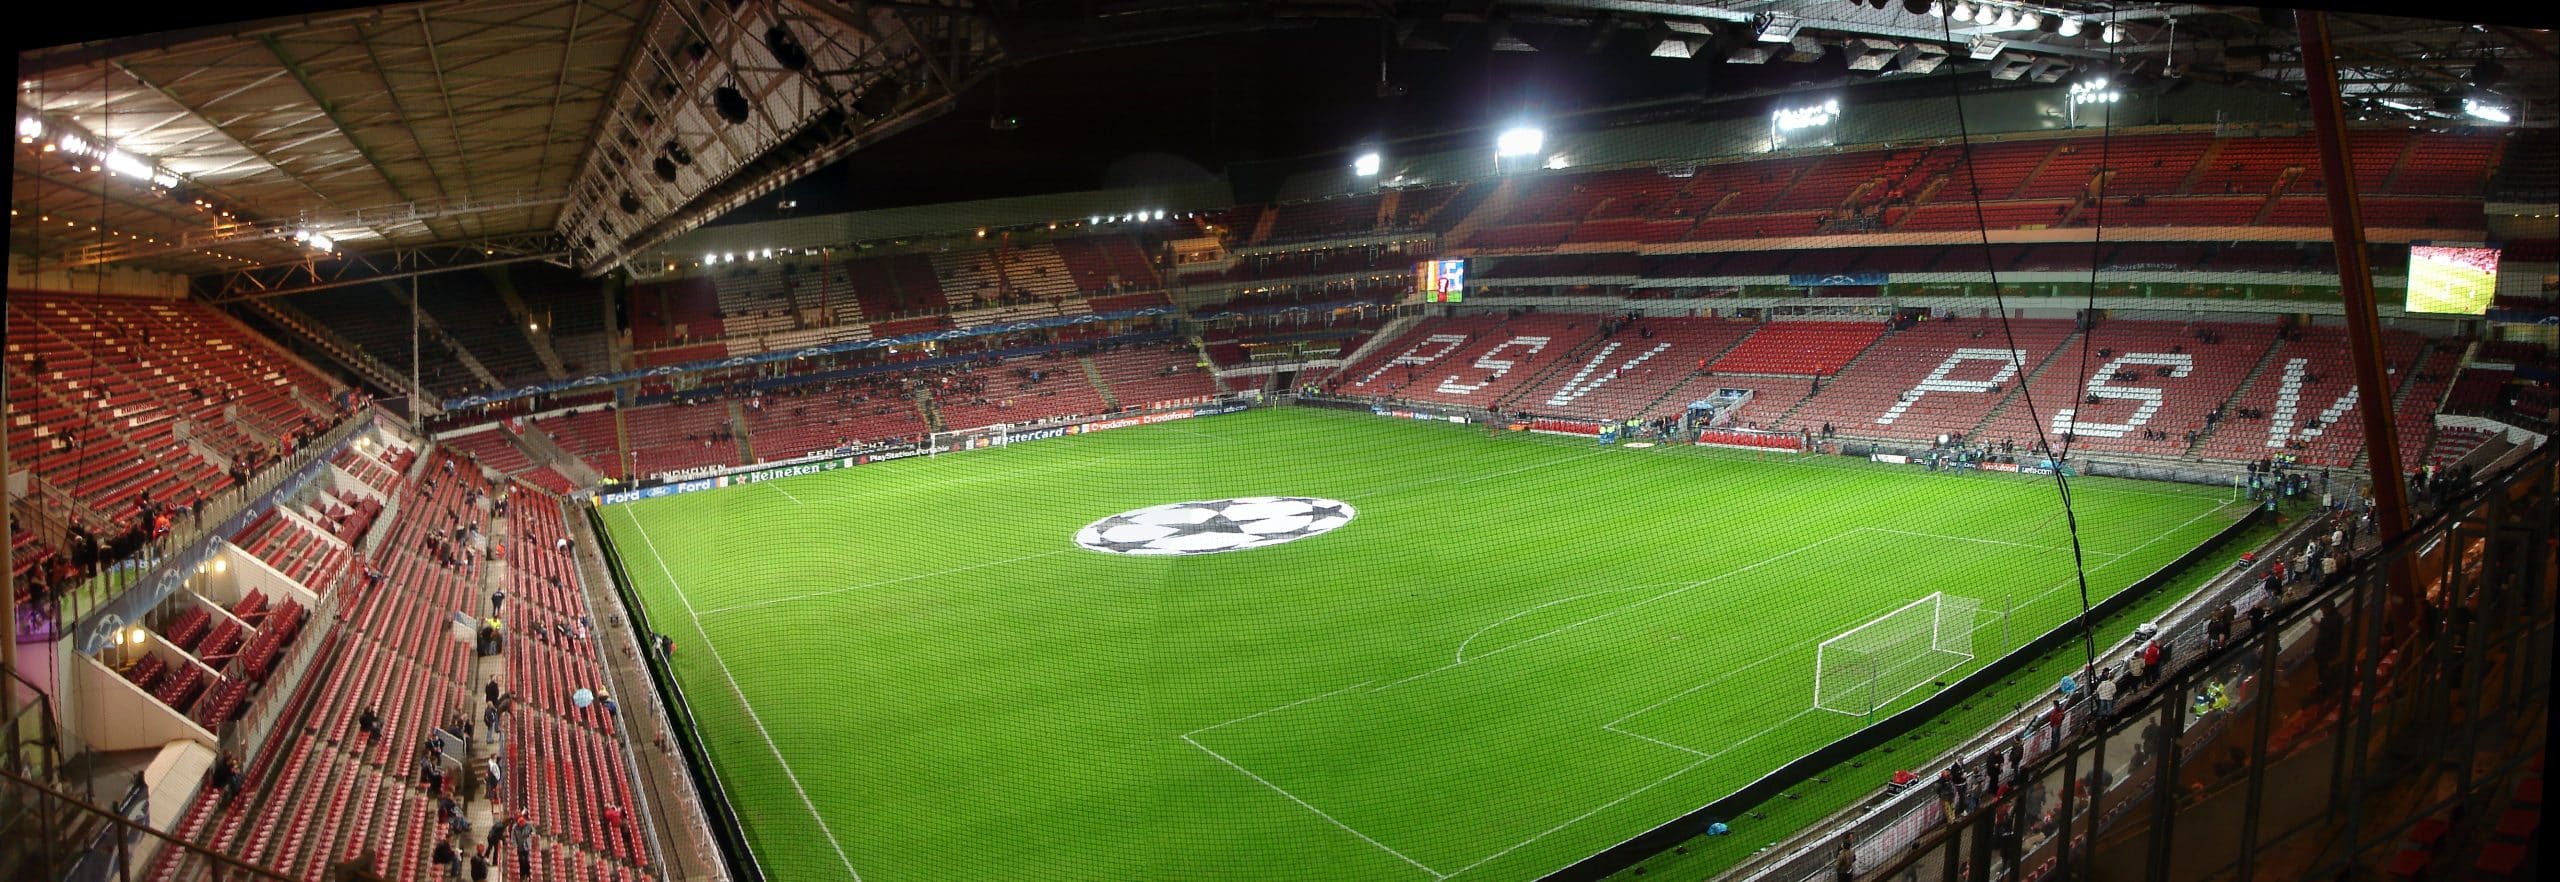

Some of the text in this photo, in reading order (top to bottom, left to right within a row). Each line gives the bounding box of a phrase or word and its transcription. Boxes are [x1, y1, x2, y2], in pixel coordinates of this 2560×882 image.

[1100, 418, 1139, 430] vodafone
[1152, 412, 1191, 423] vodafone
[992, 428, 1064, 446] MasterCard
[650, 464, 726, 480] EINDHOVEN
[751, 464, 820, 483] Heineken
[1985, 463, 2016, 472] vodafone
[678, 479, 711, 493] Ford
[607, 490, 639, 504] Ford
